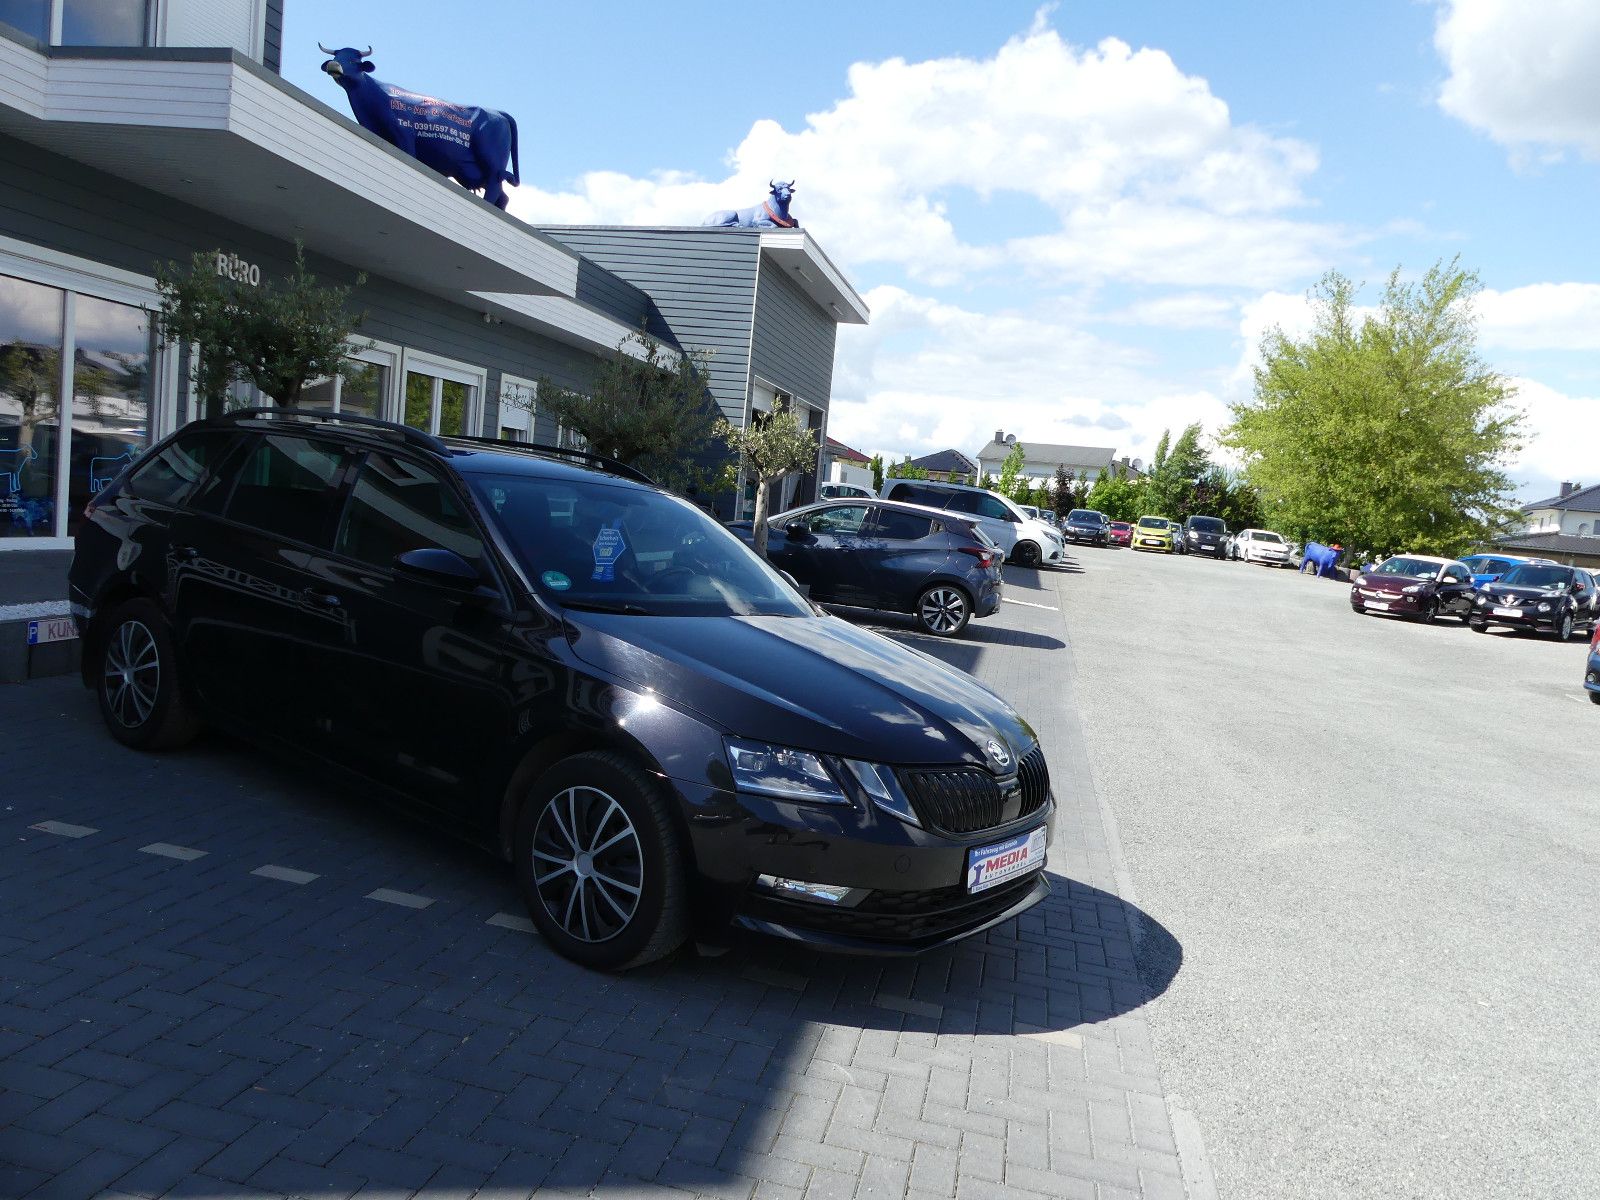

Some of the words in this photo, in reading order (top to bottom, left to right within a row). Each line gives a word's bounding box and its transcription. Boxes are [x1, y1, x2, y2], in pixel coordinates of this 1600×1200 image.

[398, 118, 412, 128] Tel.
[414, 122, 448, 133] 0391/597
[48, 620, 78, 640] KUN
[985, 847, 1028, 873] MEDIA
